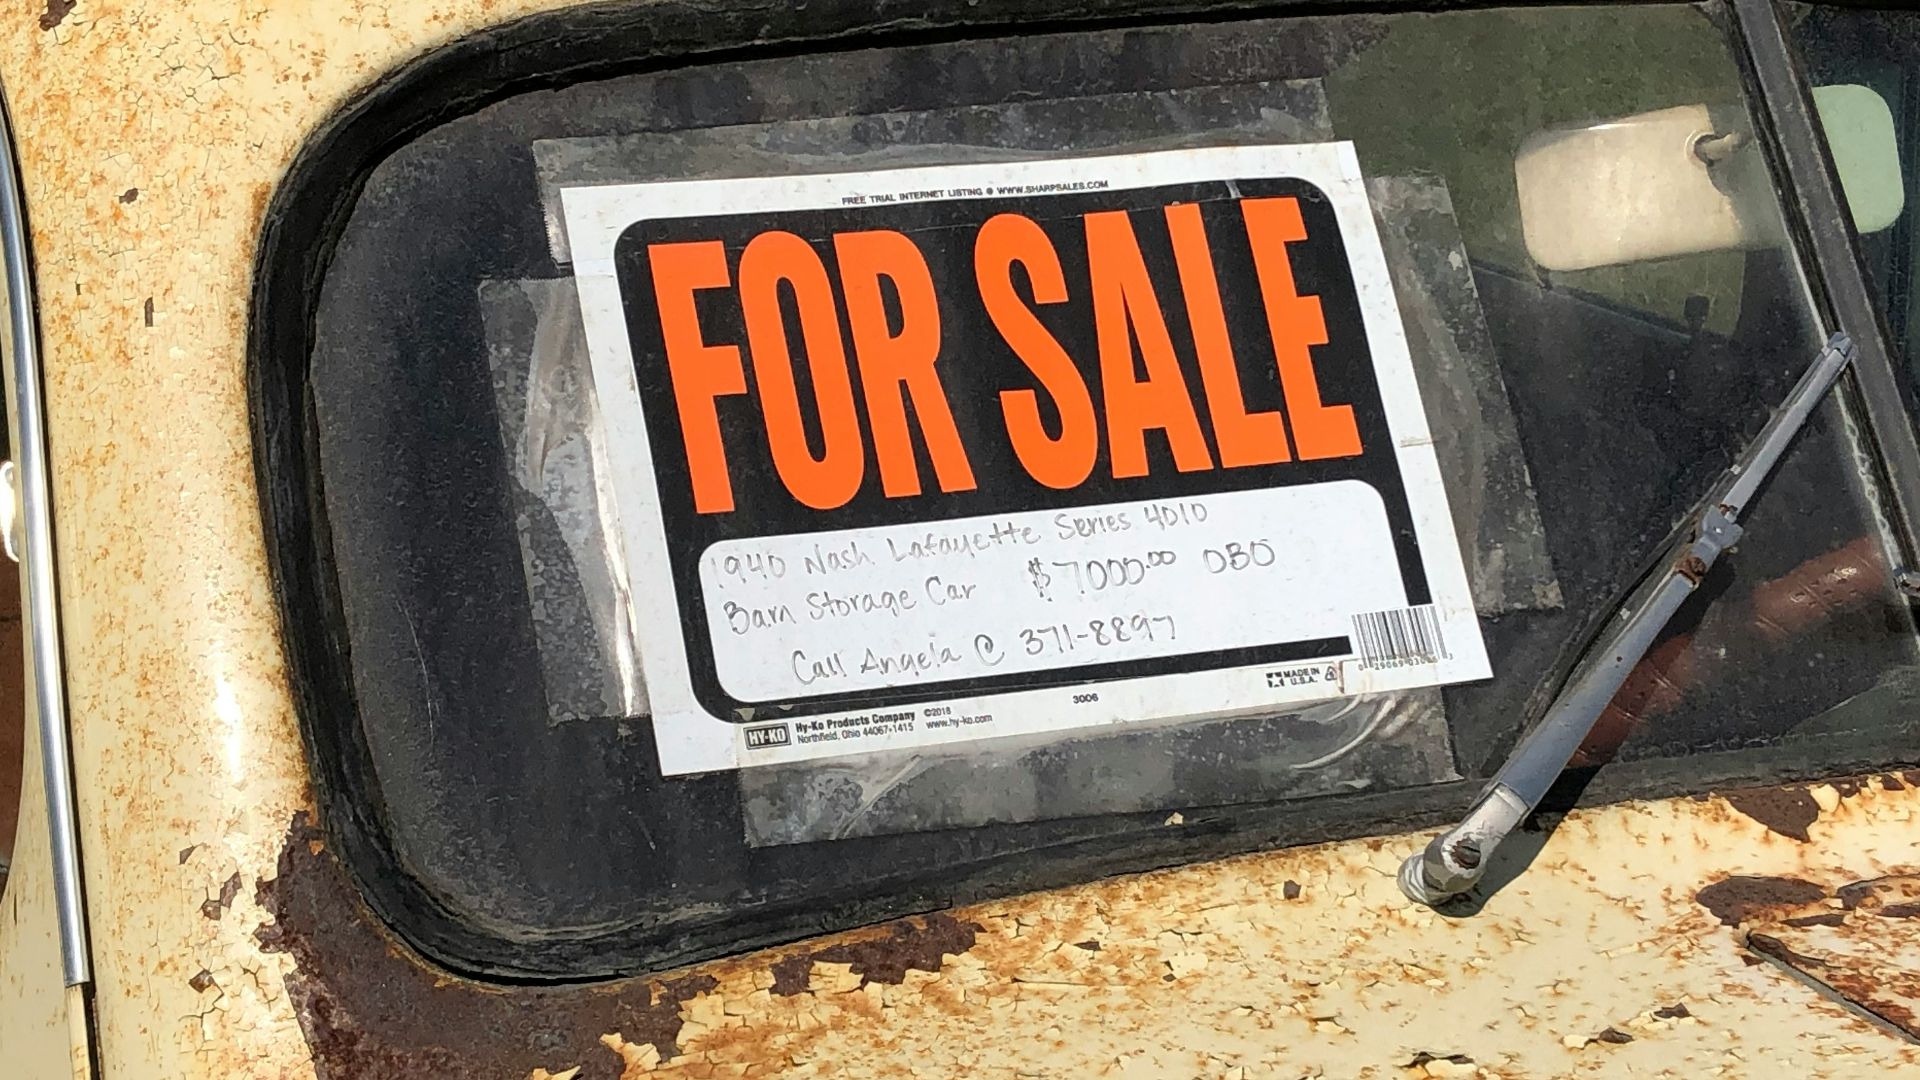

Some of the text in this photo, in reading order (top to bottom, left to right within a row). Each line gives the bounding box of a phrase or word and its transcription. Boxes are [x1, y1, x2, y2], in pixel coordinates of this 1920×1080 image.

[842, 195, 867, 206] FREE
[869, 194, 896, 203] TRIAL
[899, 189, 945, 201] INTERNET
[948, 187, 983, 198] LISTING
[996, 179, 1109, 195] WWW.SHARPSALES.COM
[647, 196, 1364, 515] FOR SALE
[711, 502, 1209, 589] 1940 Nash Lafayette Series 4010
[723, 600, 797, 635] Barn
[804, 588, 917, 621] Storage
[924, 574, 977, 606] Car
[1202, 538, 1276, 574] OBO
[791, 649, 849, 685] Call
[859, 641, 962, 678] Angela
[1018, 614, 1176, 656] 371-8897
[1283, 667, 1320, 678] MADE IN
[1290, 676, 1318, 686] U.S.A.
[1072, 693, 1099, 704] 3006
[795, 711, 915, 734] Hy-Ko Products Company
[925, 714, 993, 730] www.hy-ko.com
[748, 726, 787, 747] HY-KO
[841, 728, 861, 740] Ohio
